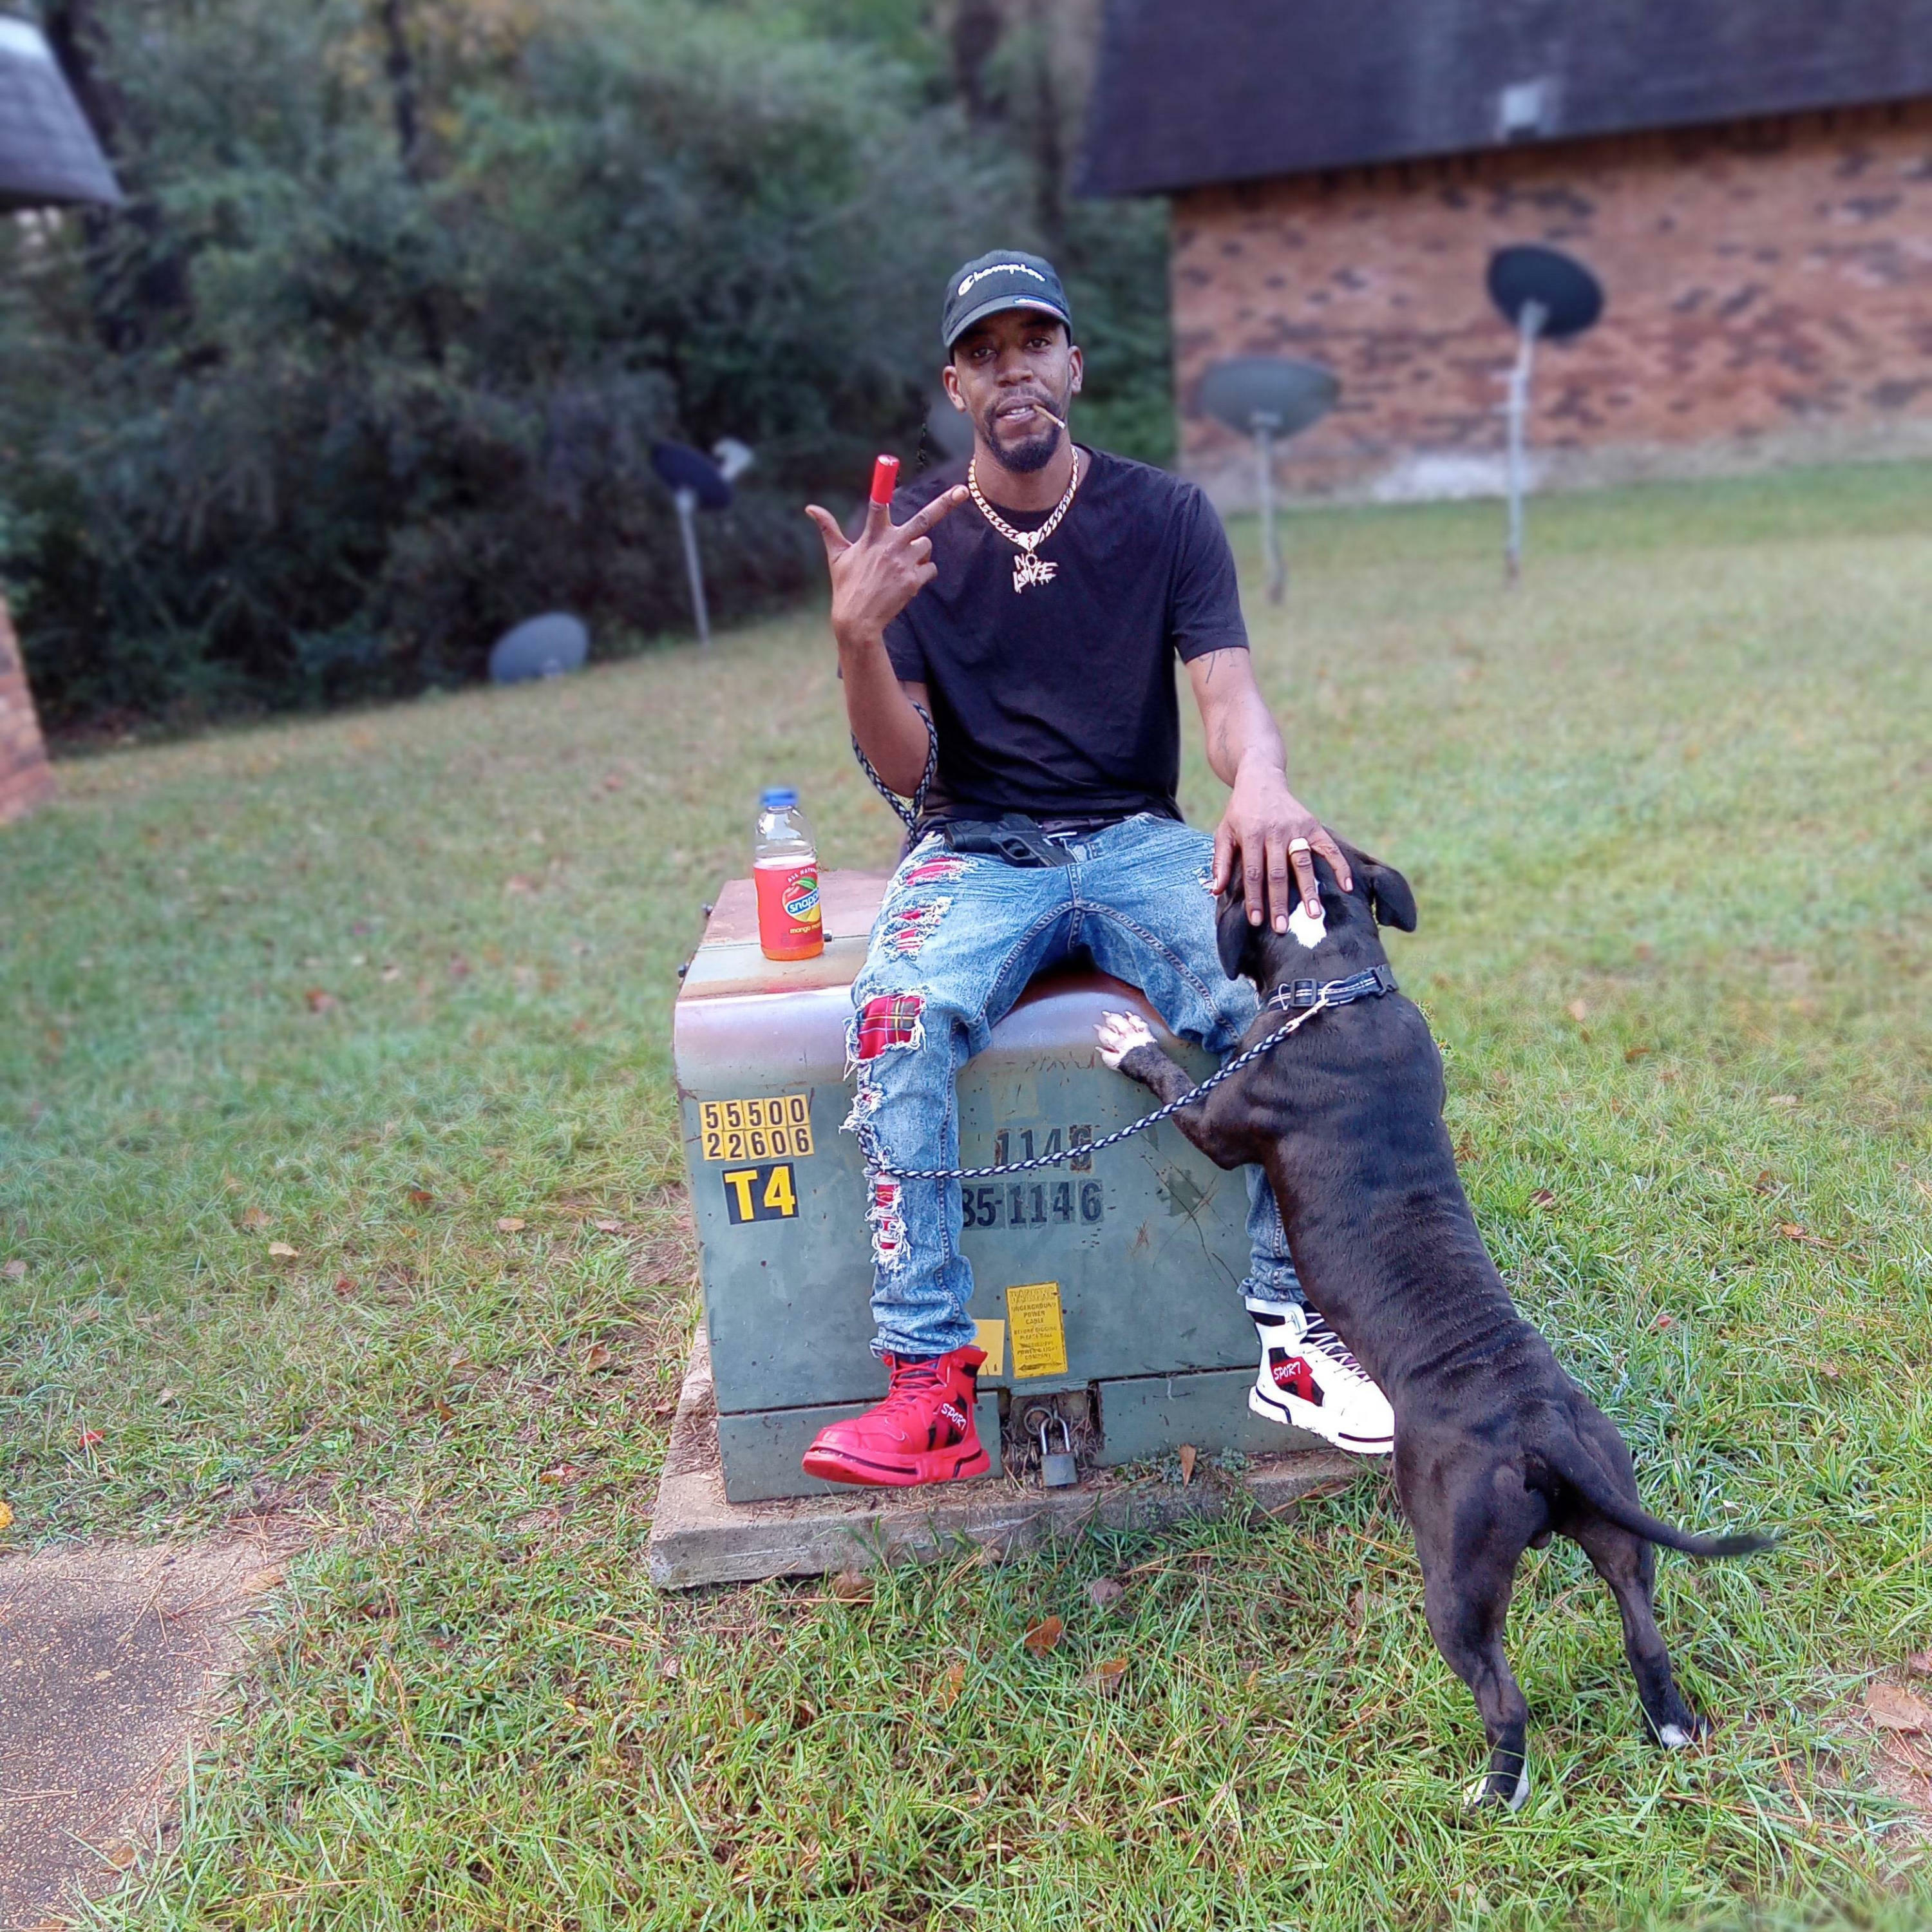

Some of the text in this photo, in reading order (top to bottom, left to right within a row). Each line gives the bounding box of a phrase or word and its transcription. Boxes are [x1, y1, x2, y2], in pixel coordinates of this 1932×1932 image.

[1014, 553, 1037, 570] NO
[788, 873, 799, 883] ALL
[790, 925, 811, 934] mango
[705, 1098, 805, 1129] 55500
[707, 1128, 810, 1158] 22606
[724, 1166, 796, 1221] T4
[1273, 1361, 1301, 1380] SPORT
[941, 1403, 966, 1430] SPORT
